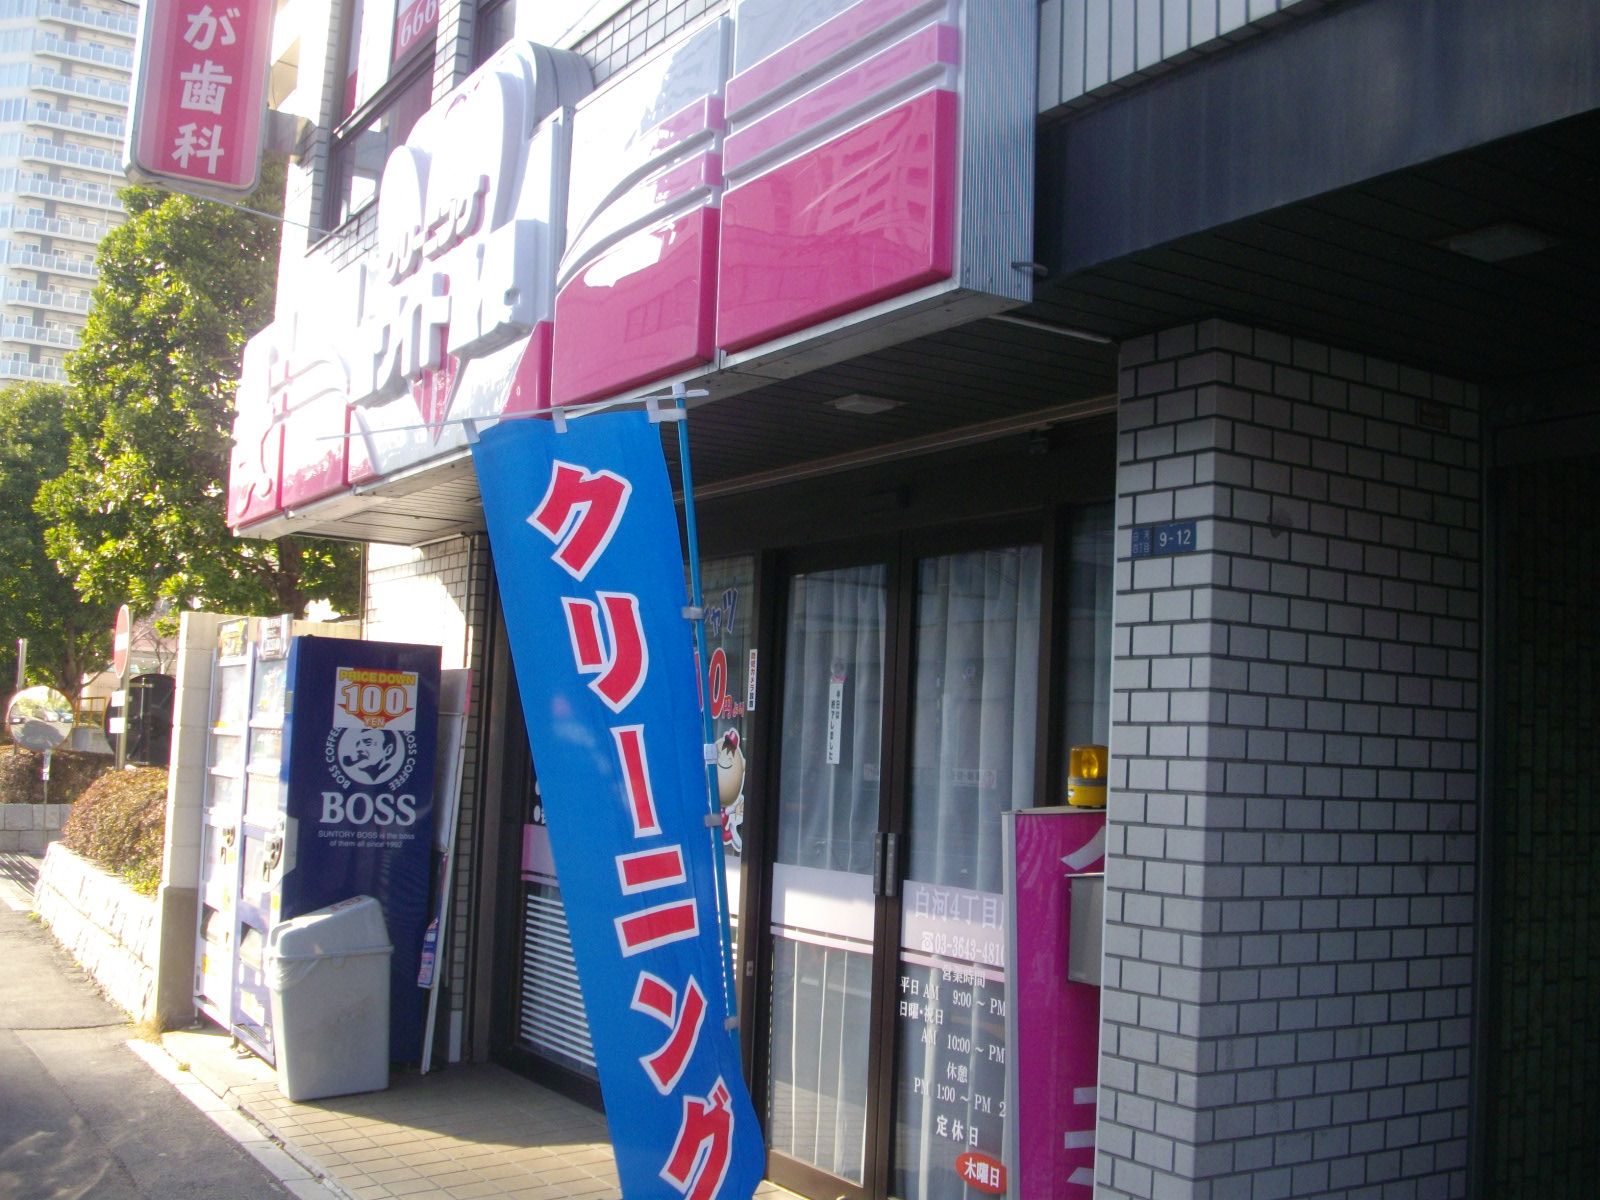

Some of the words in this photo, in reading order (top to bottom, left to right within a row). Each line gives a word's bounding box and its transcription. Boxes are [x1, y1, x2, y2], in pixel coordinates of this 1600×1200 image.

[171, 7, 241, 175] が歯科
[1159, 529, 1191, 547] 9-12
[342, 683, 407, 717] 100
[365, 716, 385, 728] YEN
[328, 764, 351, 790] BOSS
[388, 757, 416, 791] COFFEE
[319, 792, 417, 826] BOSS
[318, 830, 354, 839] SUNTORY
[356, 831, 377, 839] BOSS
[526, 459, 733, 1200] クリーニング
[942, 965, 986, 989] 営業時間
[901, 976, 919, 996] 平日
[923, 984, 939, 1001] AM
[952, 990, 972, 1008] 9:00
[990, 998, 1006, 1017] PM
[921, 1027, 937, 1046] AM
[947, 1034, 970, 1054] 10:00
[988, 1045, 1006, 1064] PM
[947, 1061, 968, 1083] 休憩
[914, 1077, 929, 1096] PM
[936, 1083, 955, 1102] 1:00
[974, 1094, 991, 1114] PM
[936, 1114, 978, 1147] 定休日
[964, 1157, 1000, 1188] 木曜日
